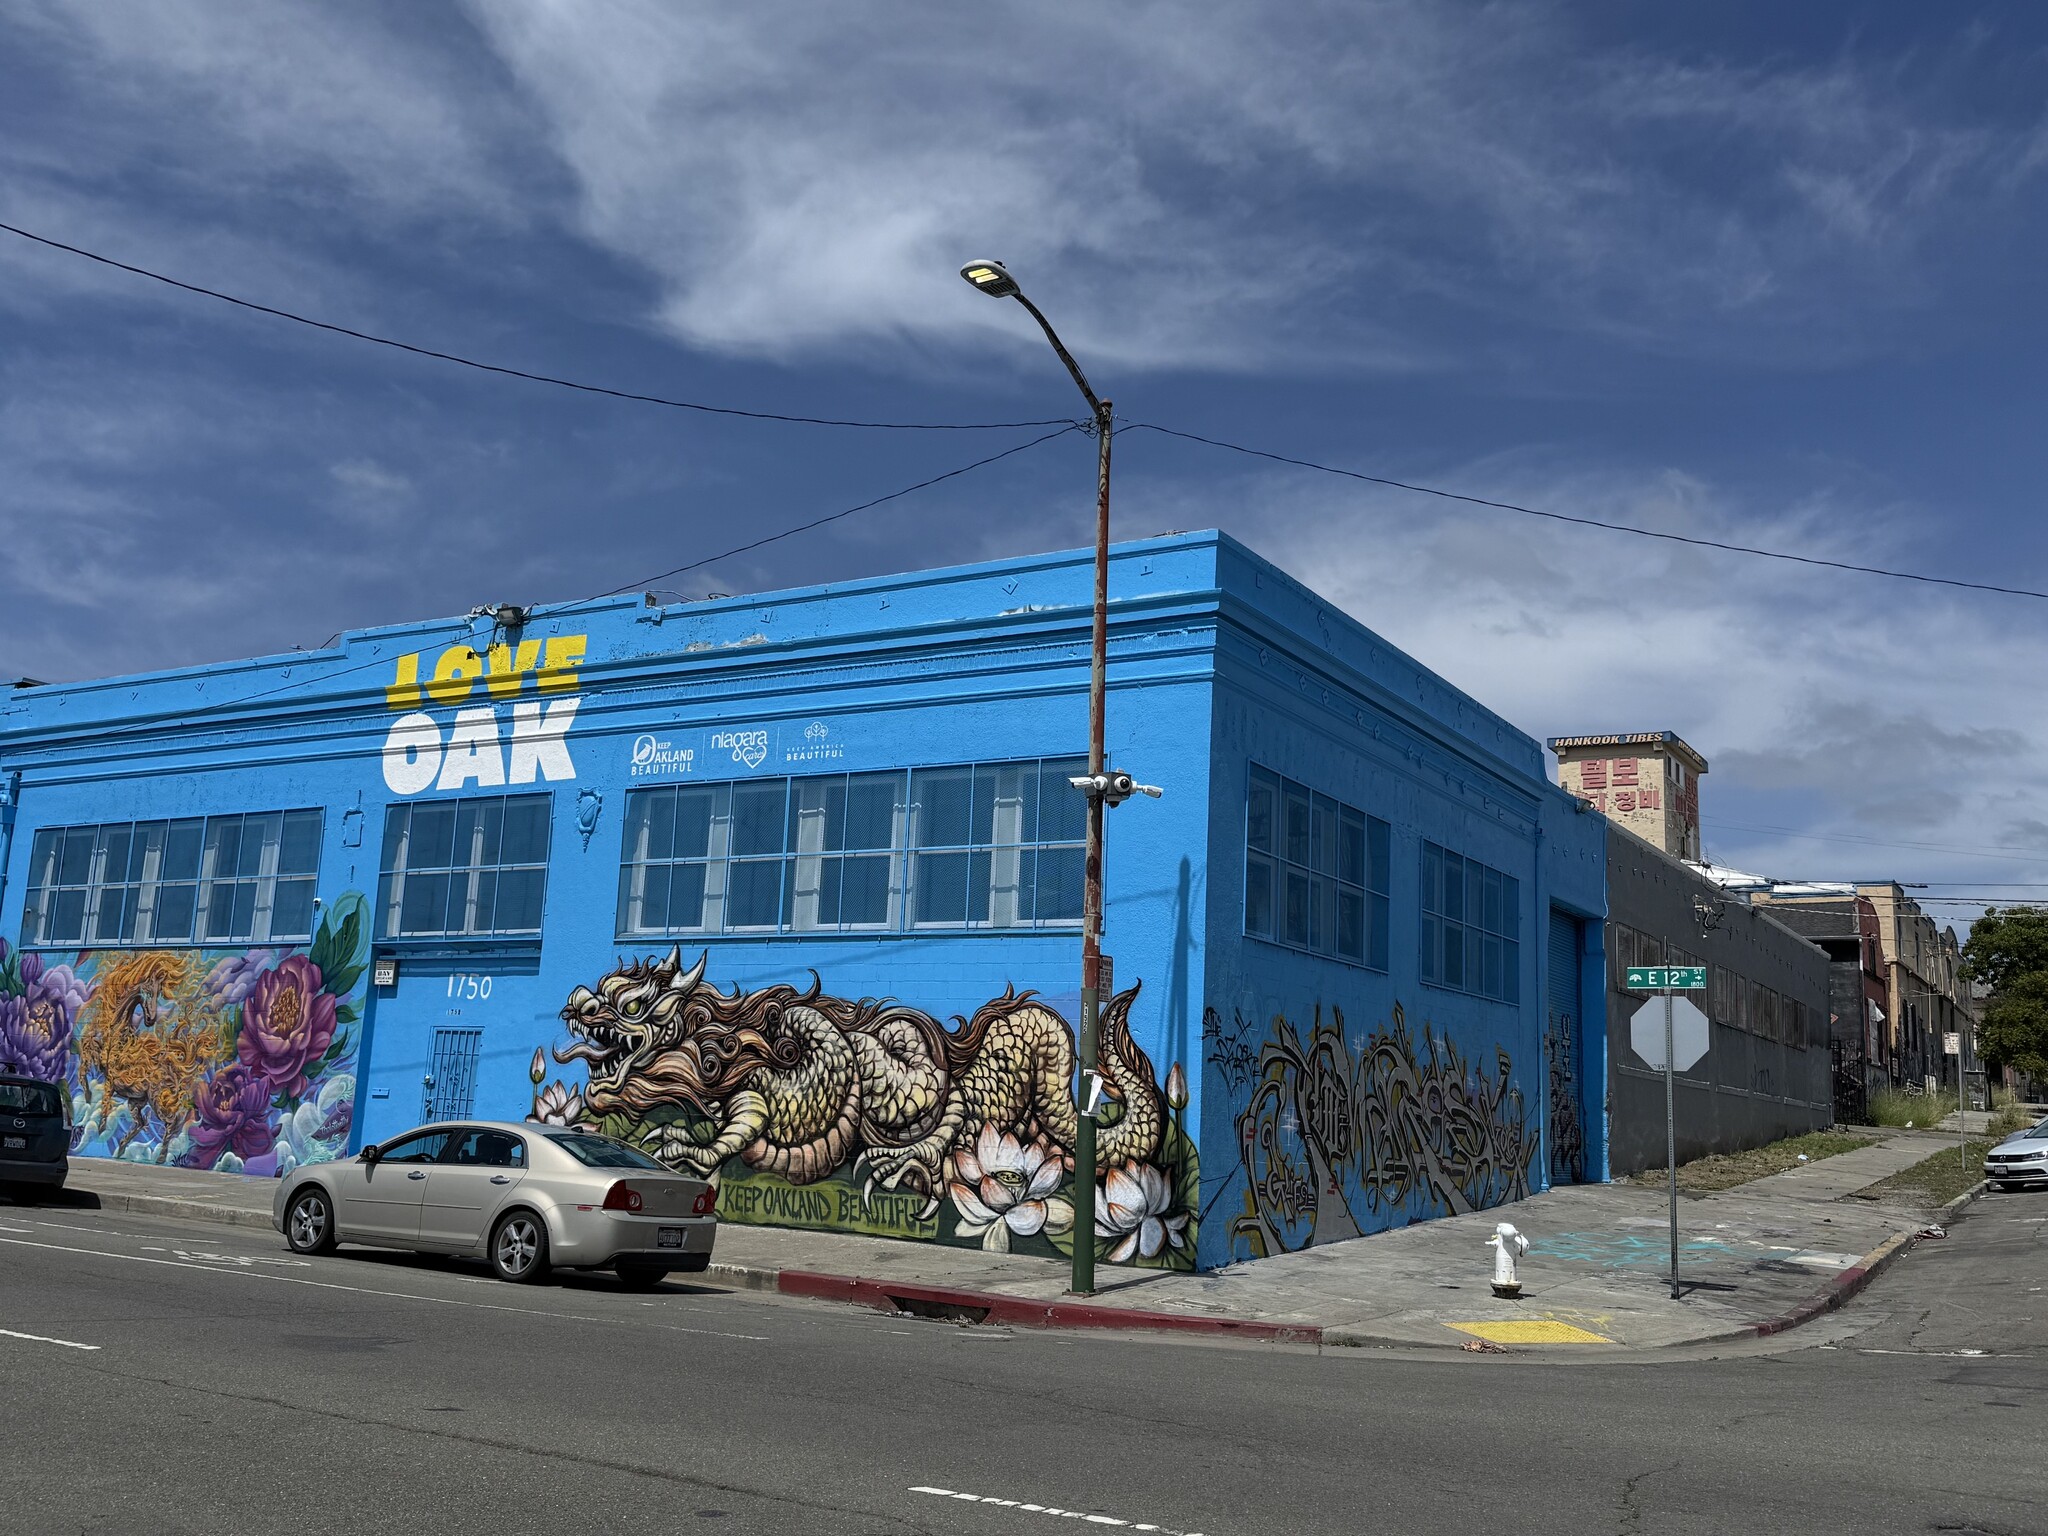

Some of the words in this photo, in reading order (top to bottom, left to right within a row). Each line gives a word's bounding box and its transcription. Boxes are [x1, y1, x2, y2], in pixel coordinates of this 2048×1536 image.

[385, 634, 587, 710] LOVE
[382, 697, 582, 794] OAK
[711, 730, 768, 761] niagara
[1555, 735, 1620, 747] HANKOOK
[1625, 732, 1663, 742] TIRES
[786, 750, 843, 761] BEAUTIFUL
[631, 763, 692, 776] BEAUTIFUL
[447, 973, 492, 1000] 1750
[1648, 972, 1657, 985] E
[723, 1183, 762, 1214] KEEP
[763, 1186, 831, 1222] OAKLAND
